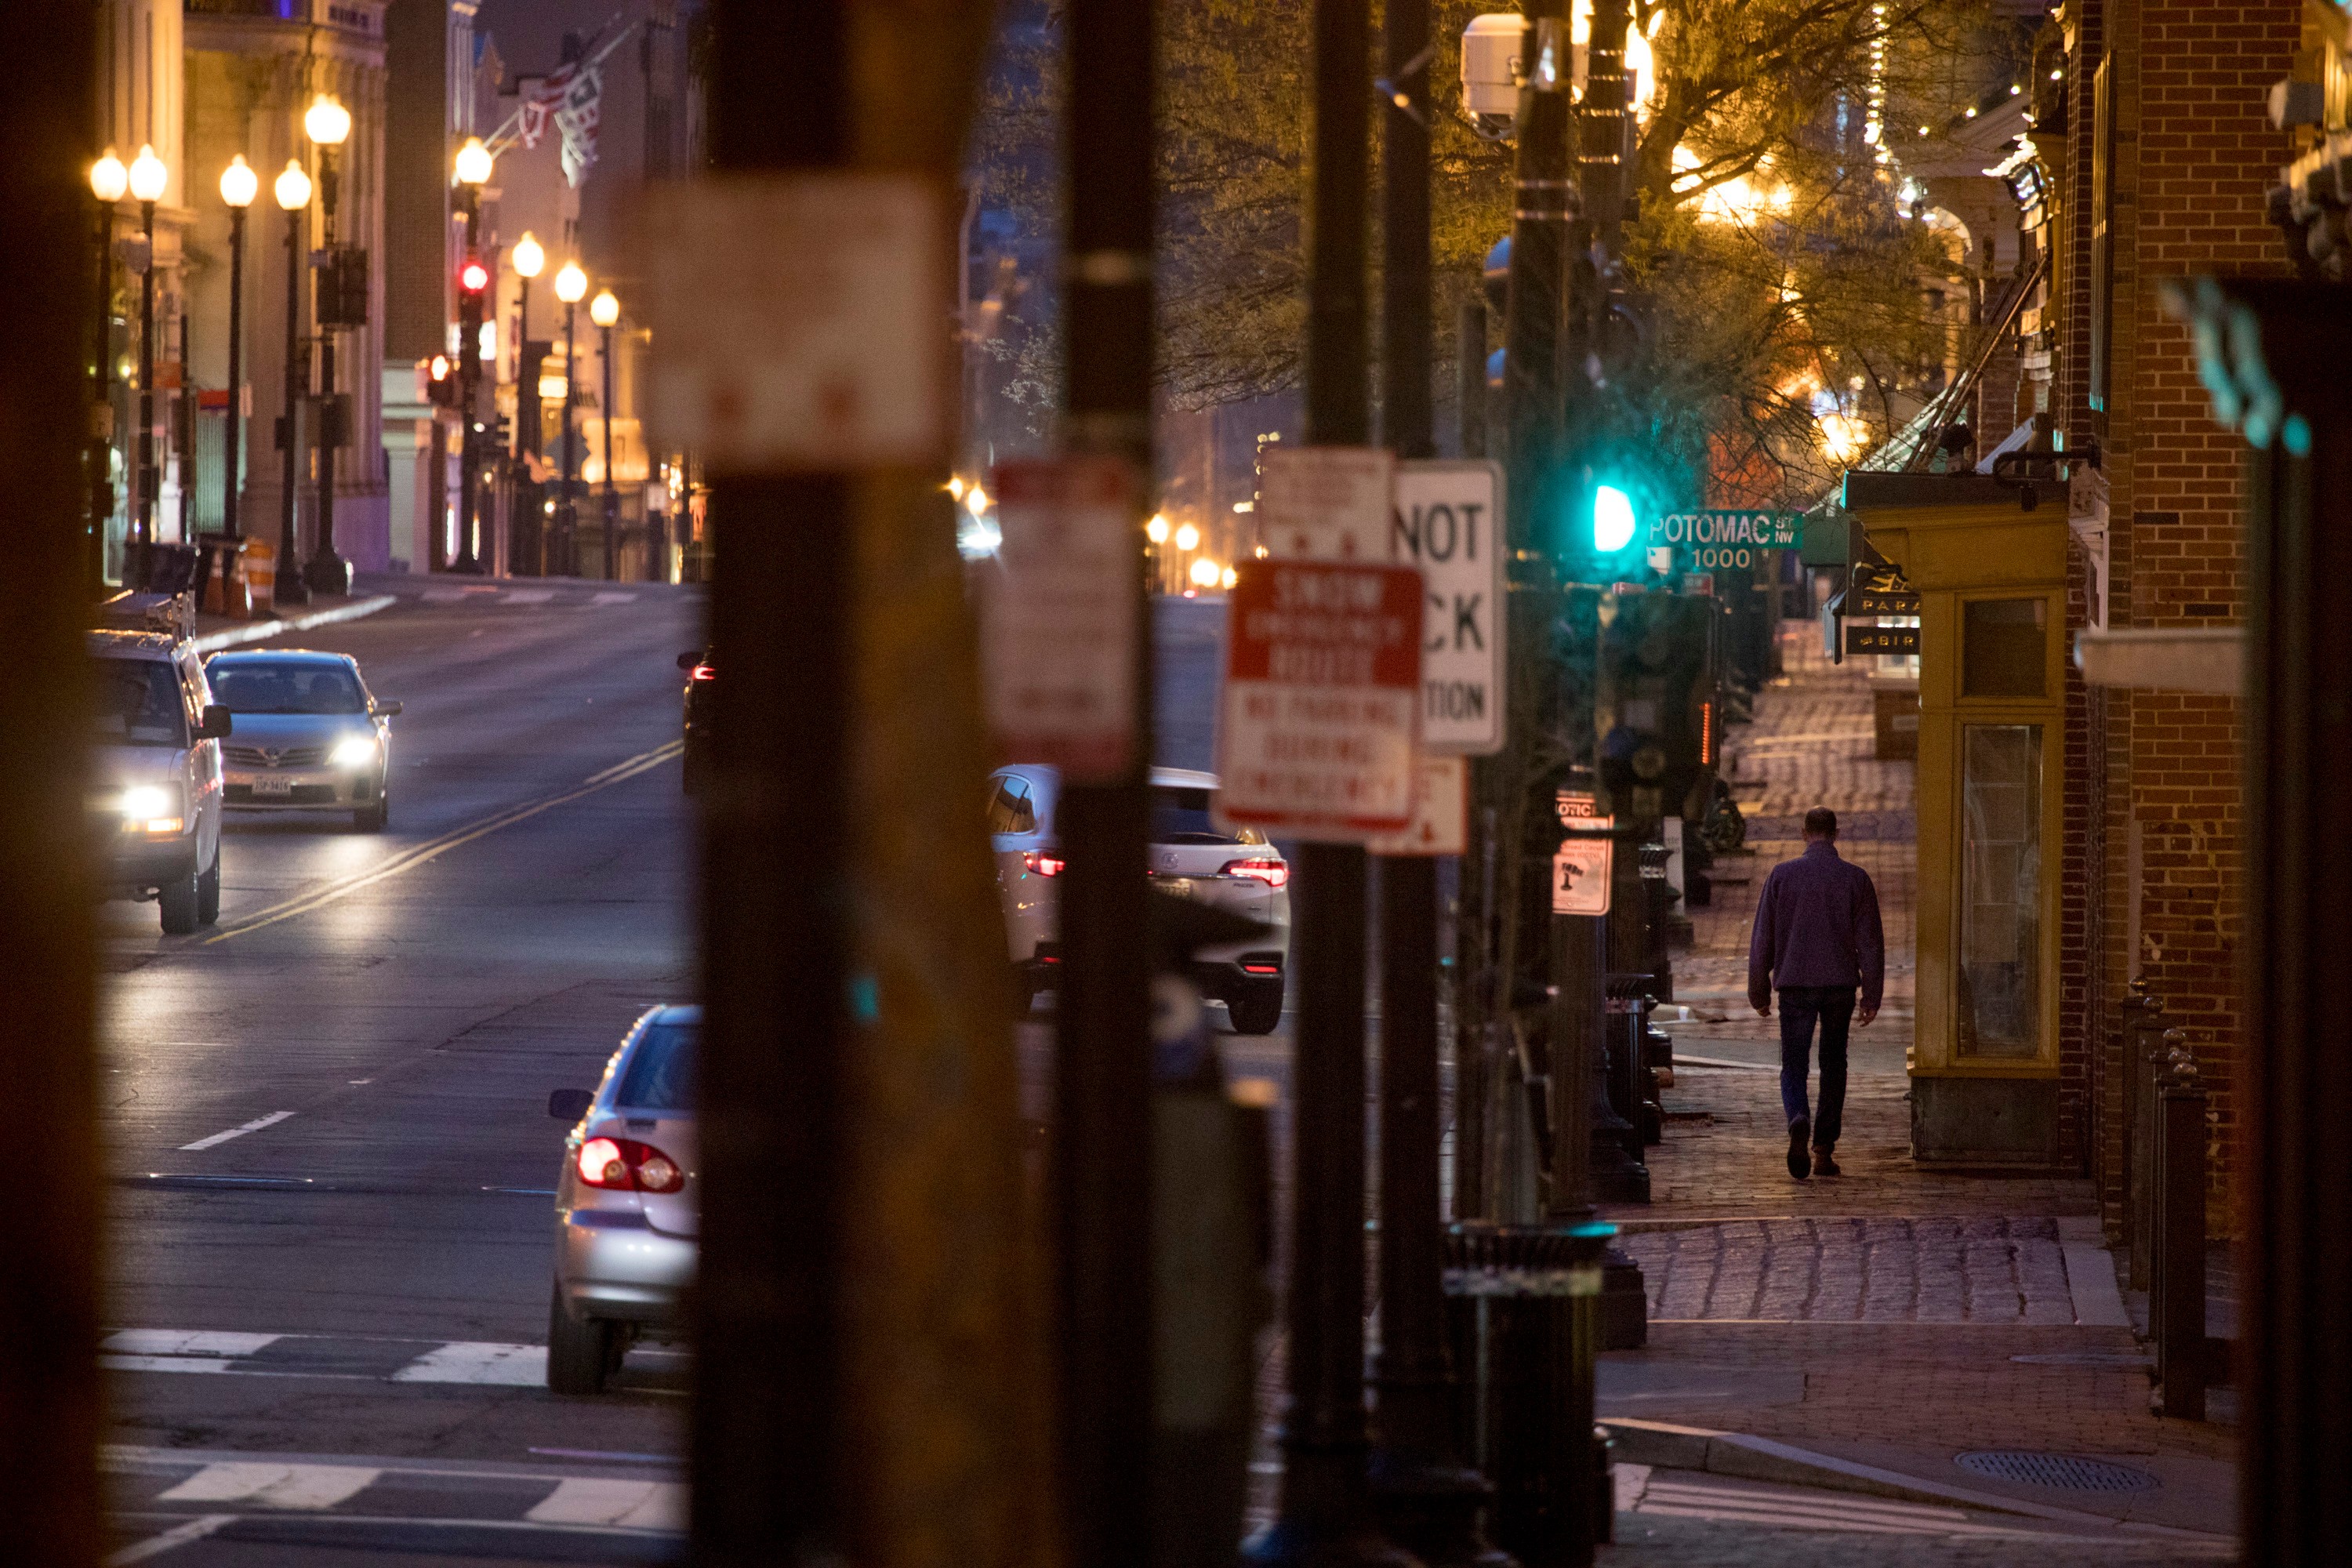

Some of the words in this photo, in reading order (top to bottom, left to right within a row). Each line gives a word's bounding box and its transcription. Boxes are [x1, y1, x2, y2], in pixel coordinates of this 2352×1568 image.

[1650, 514, 1770, 544] POTOMAC
[1776, 516, 1795, 529] ST
[1775, 531, 1795, 543] NW
[1692, 549, 1750, 568] 1000
[1555, 803, 1596, 816] OTIC
